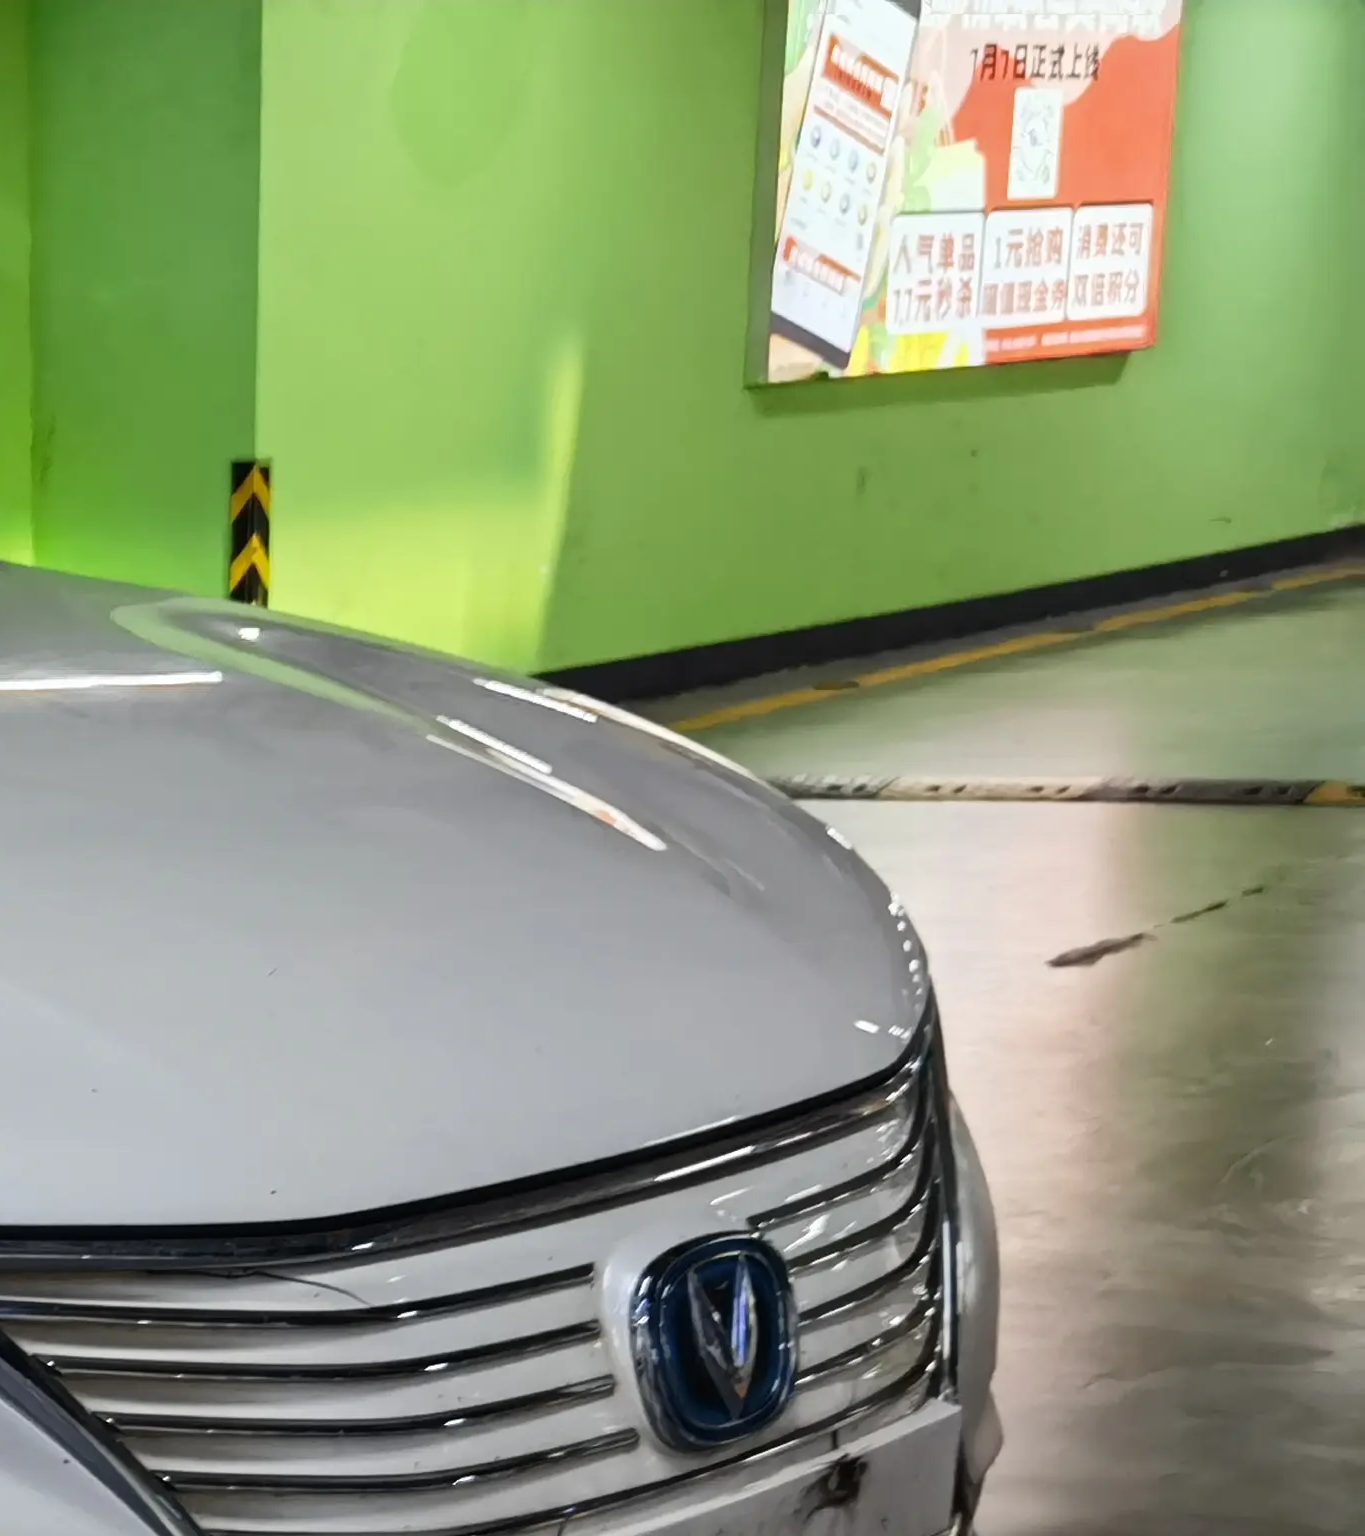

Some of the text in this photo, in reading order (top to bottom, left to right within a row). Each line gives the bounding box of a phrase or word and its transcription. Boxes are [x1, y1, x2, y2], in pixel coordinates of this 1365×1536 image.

[893, 233, 975, 275] 人气单品
[993, 226, 1064, 269] 1元抢购
[1077, 223, 1144, 259] 消费还可
